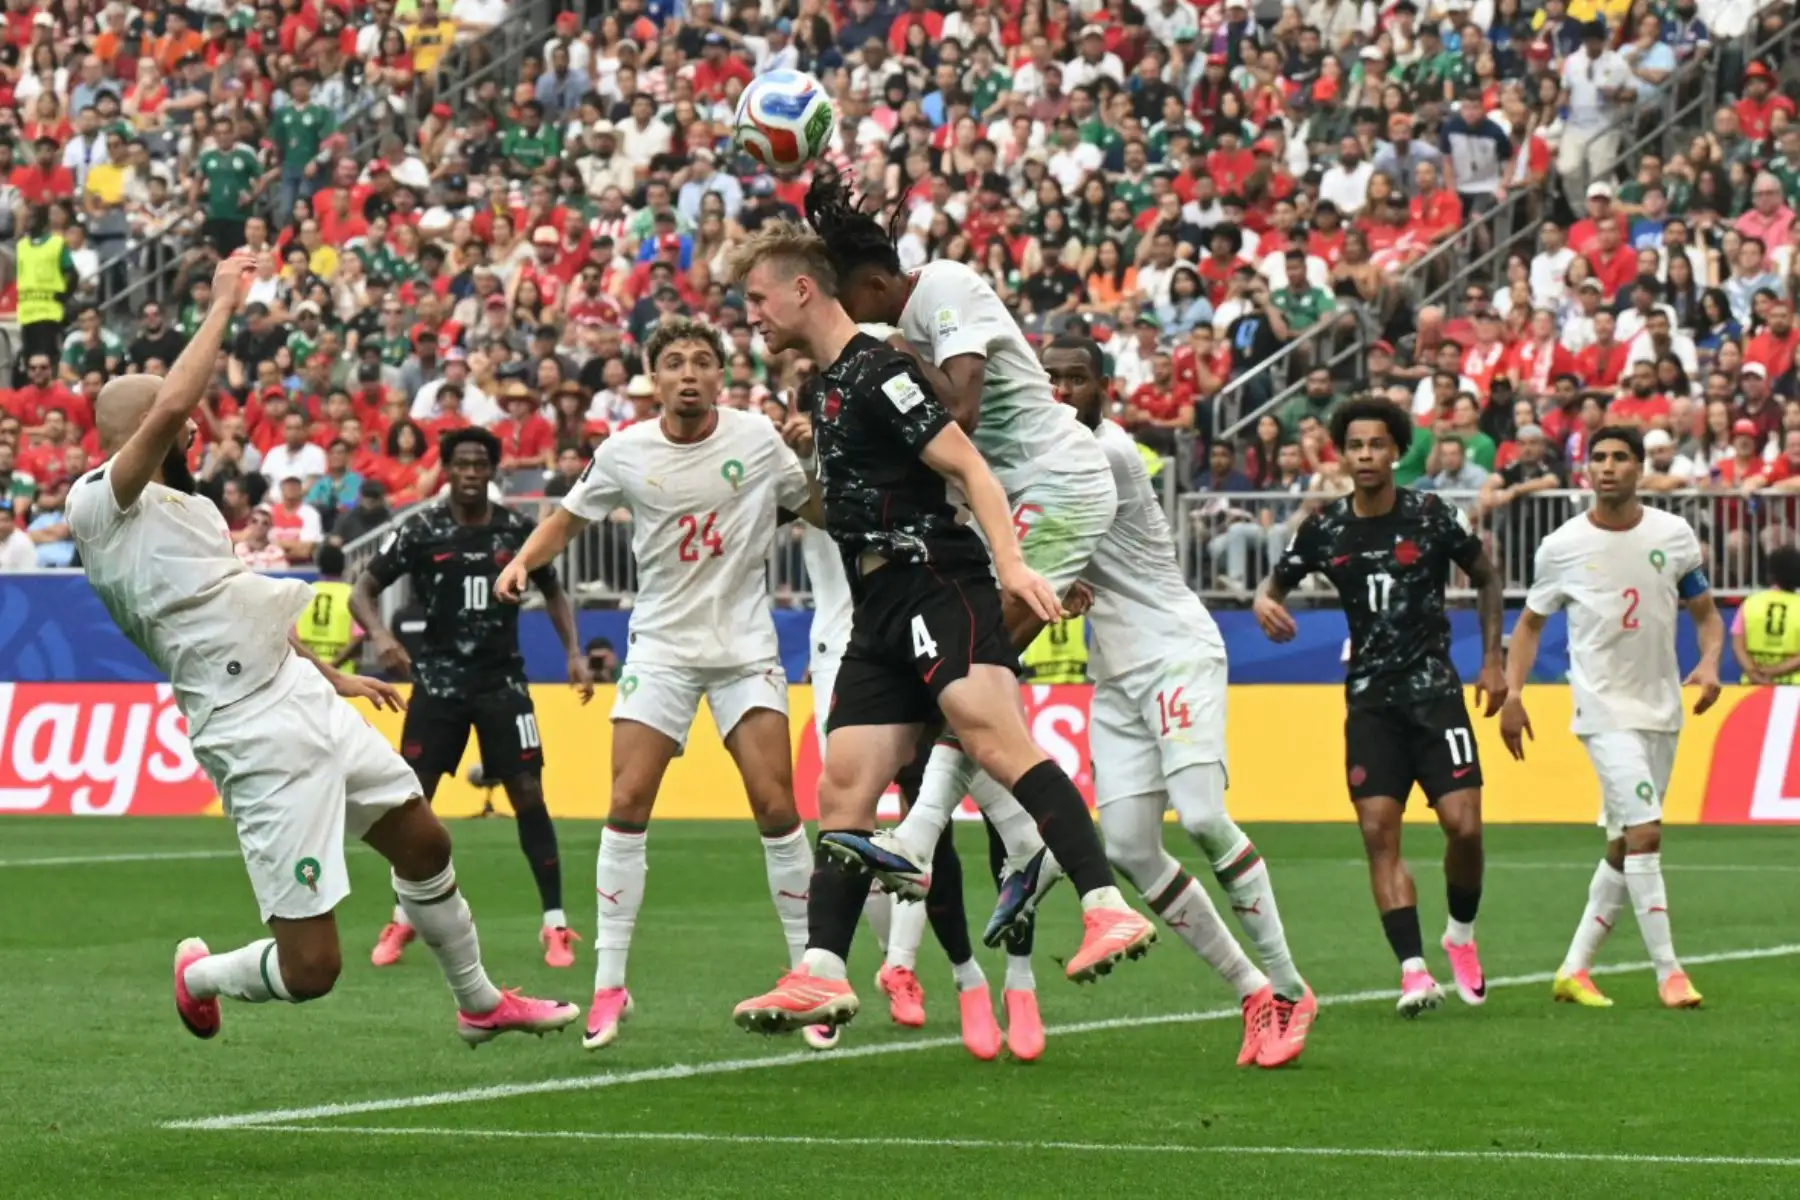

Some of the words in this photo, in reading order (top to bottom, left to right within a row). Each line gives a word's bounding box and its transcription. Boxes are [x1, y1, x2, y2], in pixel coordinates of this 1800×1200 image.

[678, 511, 724, 561] 24
[463, 576, 487, 611] 10
[1366, 573, 1395, 613] 17
[1622, 588, 1640, 629] 2
[911, 614, 938, 659] 4
[516, 713, 540, 749] 10
[1156, 687, 1192, 736] 14
[1445, 727, 1473, 766] 17
